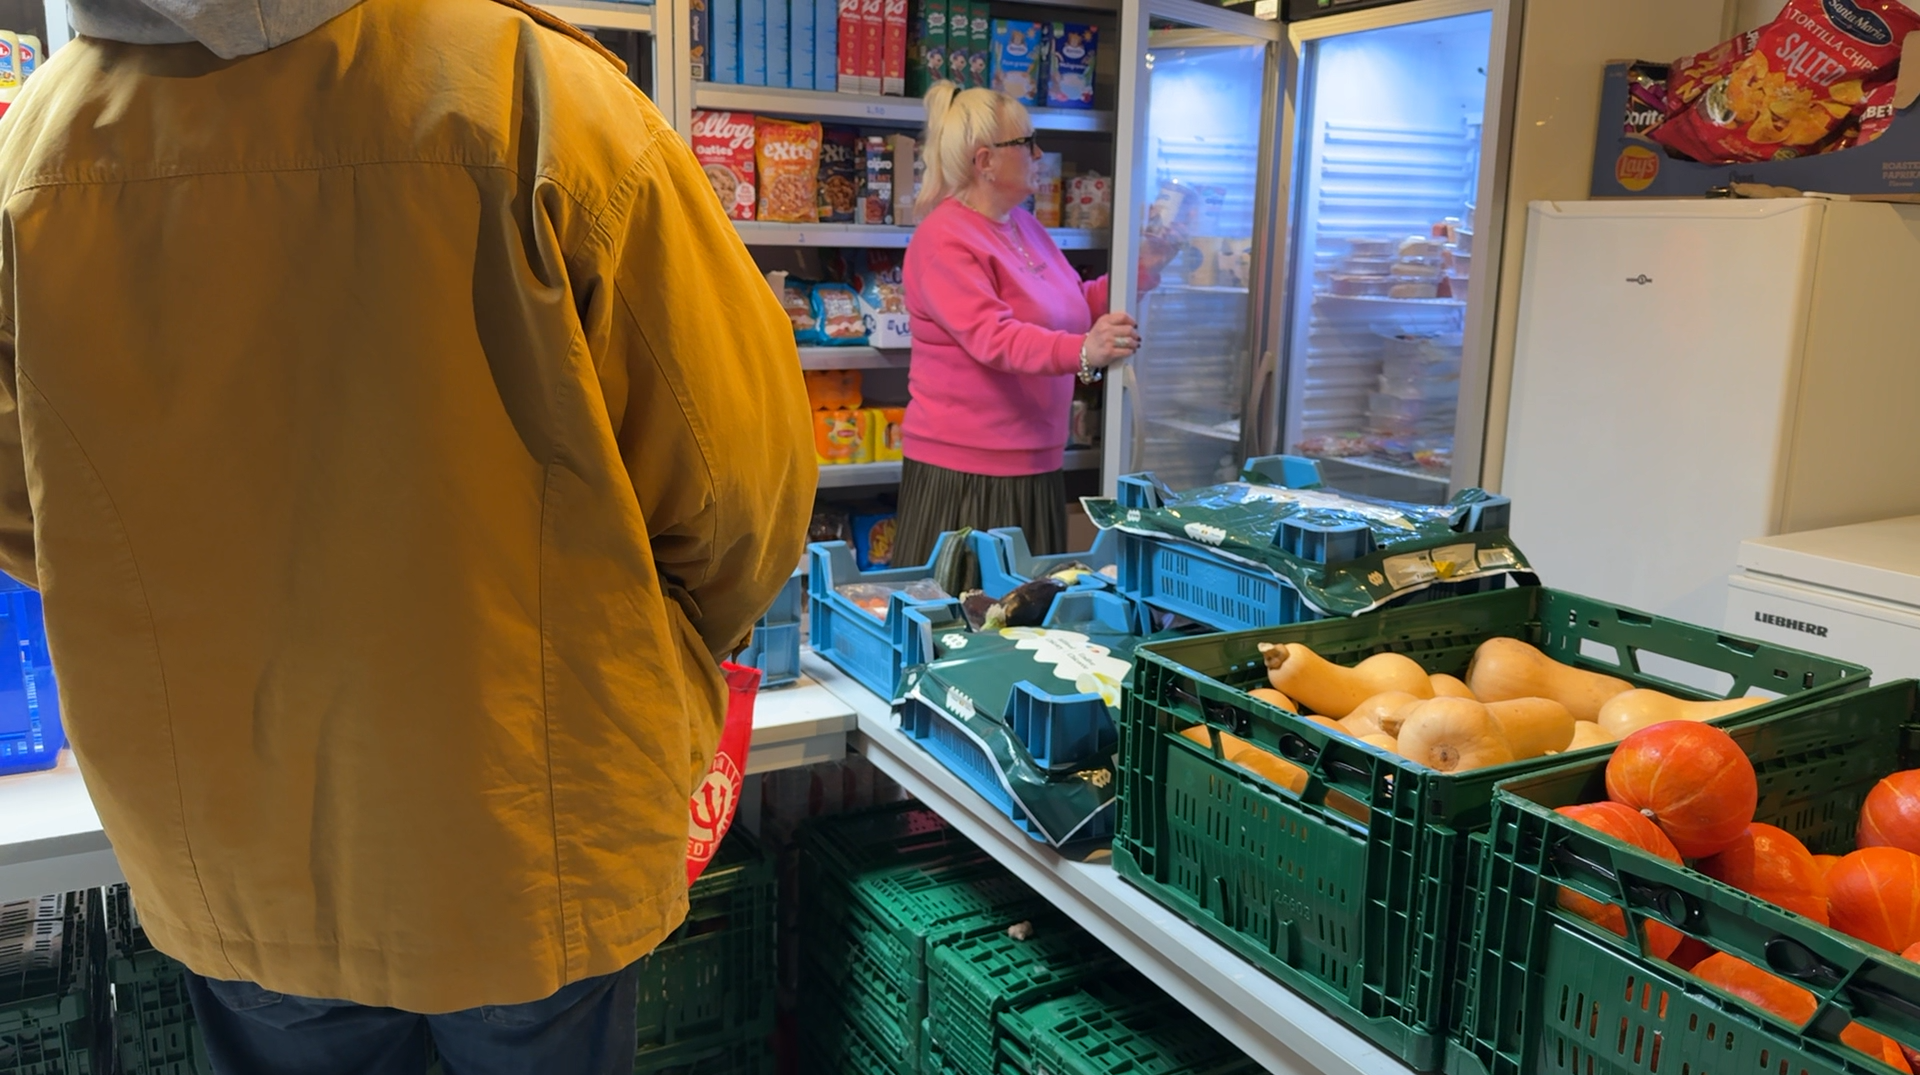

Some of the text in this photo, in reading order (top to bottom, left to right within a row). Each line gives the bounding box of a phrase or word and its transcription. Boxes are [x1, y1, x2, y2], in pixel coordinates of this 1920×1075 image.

[1790, 9, 1844, 51] TORTILLA
[1828, 0, 1886, 40] Santa Maria
[1775, 32, 1847, 87] SALTED
[1882, 162, 1920, 170] ROASTE
[1755, 611, 1828, 637] LIEBHERR
[687, 840, 704, 856] ED
